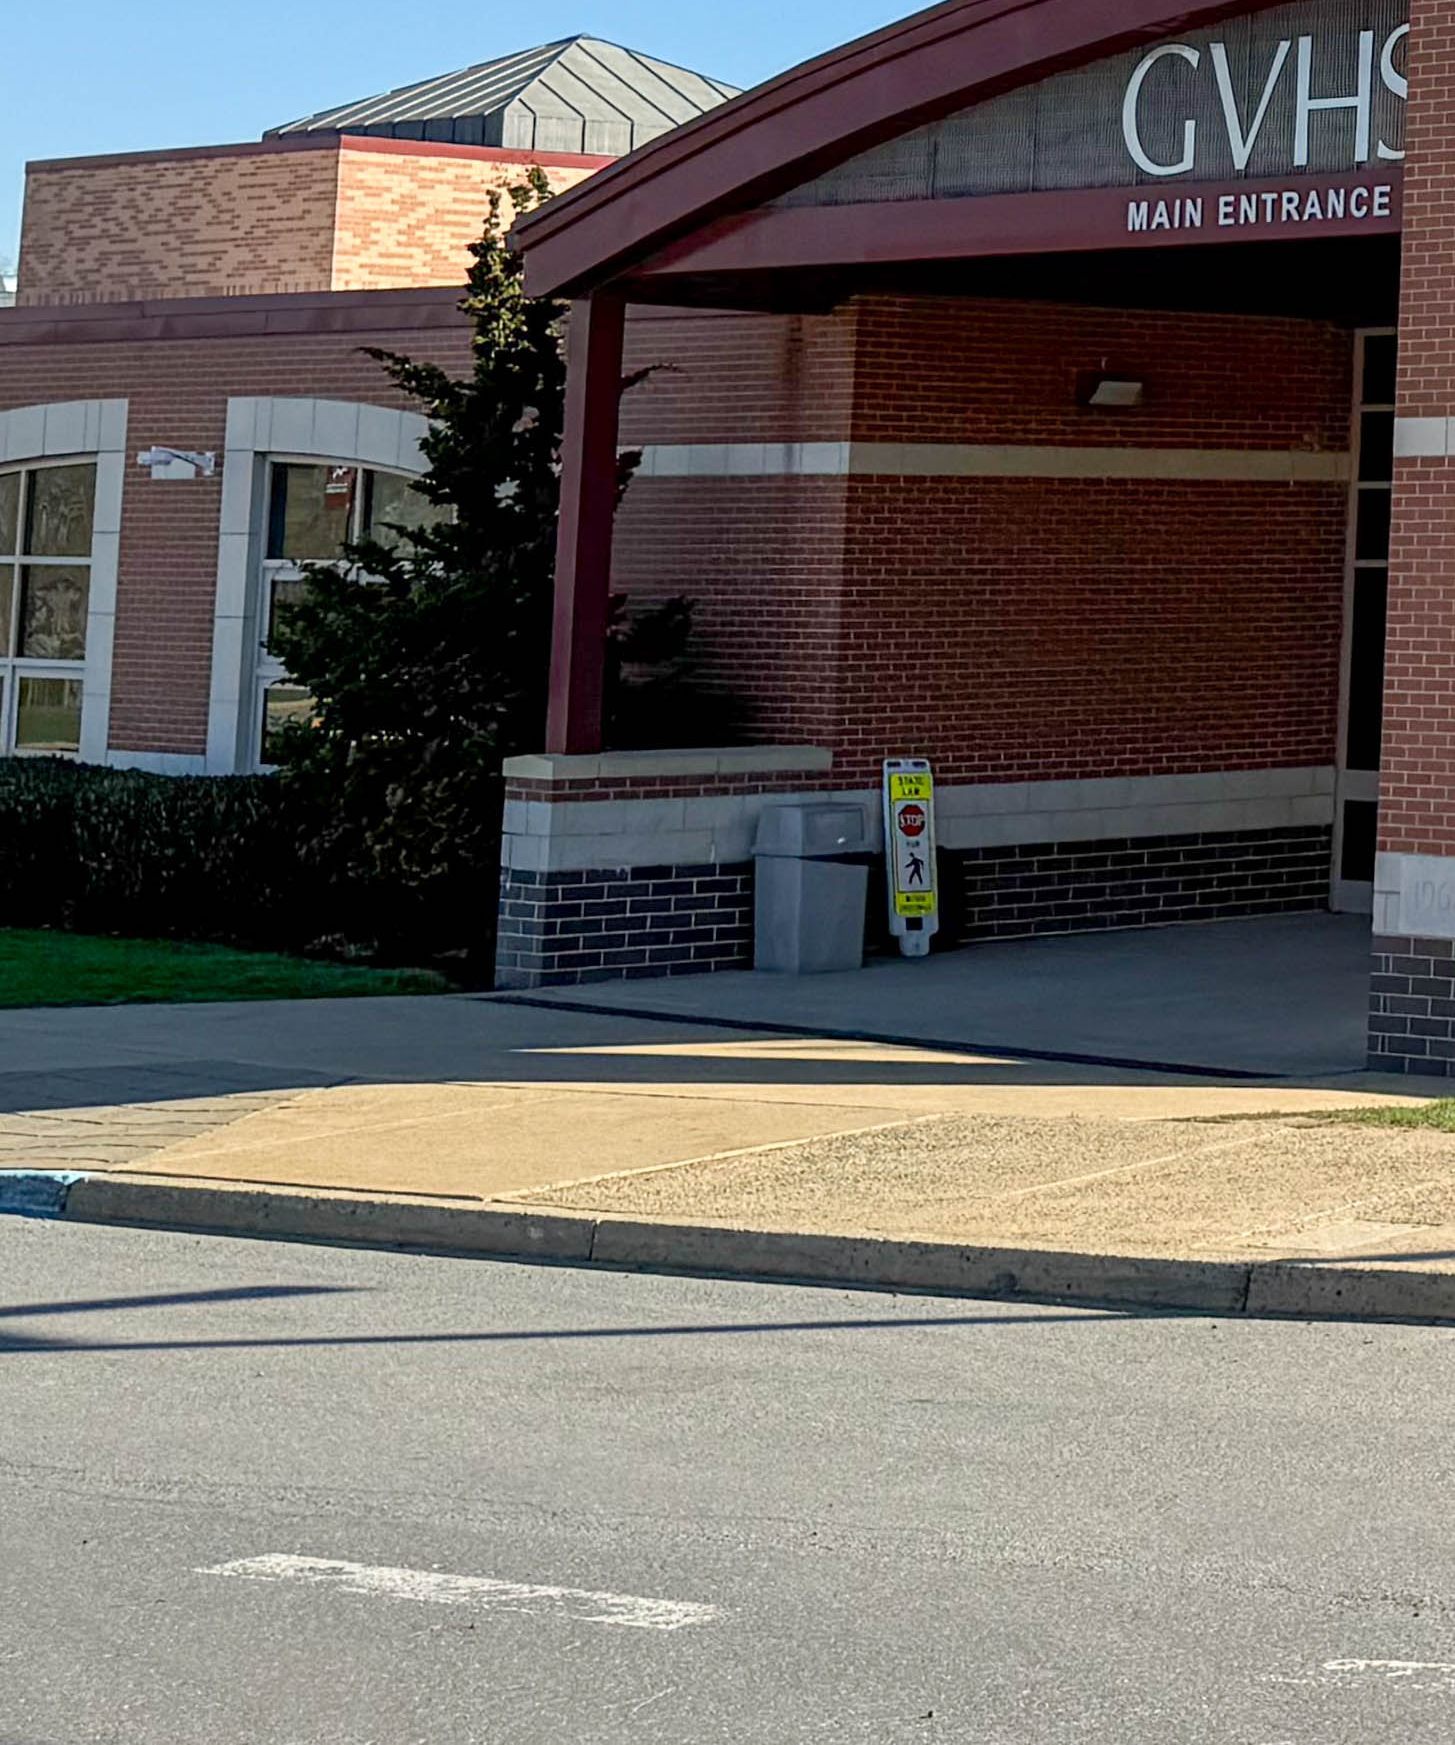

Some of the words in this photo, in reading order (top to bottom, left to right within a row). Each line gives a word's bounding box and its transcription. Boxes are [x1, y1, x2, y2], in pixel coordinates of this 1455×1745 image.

[1122, 22, 1410, 176] GVHS
[1127, 197, 1203, 232] MAIN
[1217, 184, 1392, 226] ENTRANCE
[899, 814, 925, 827] STOP
